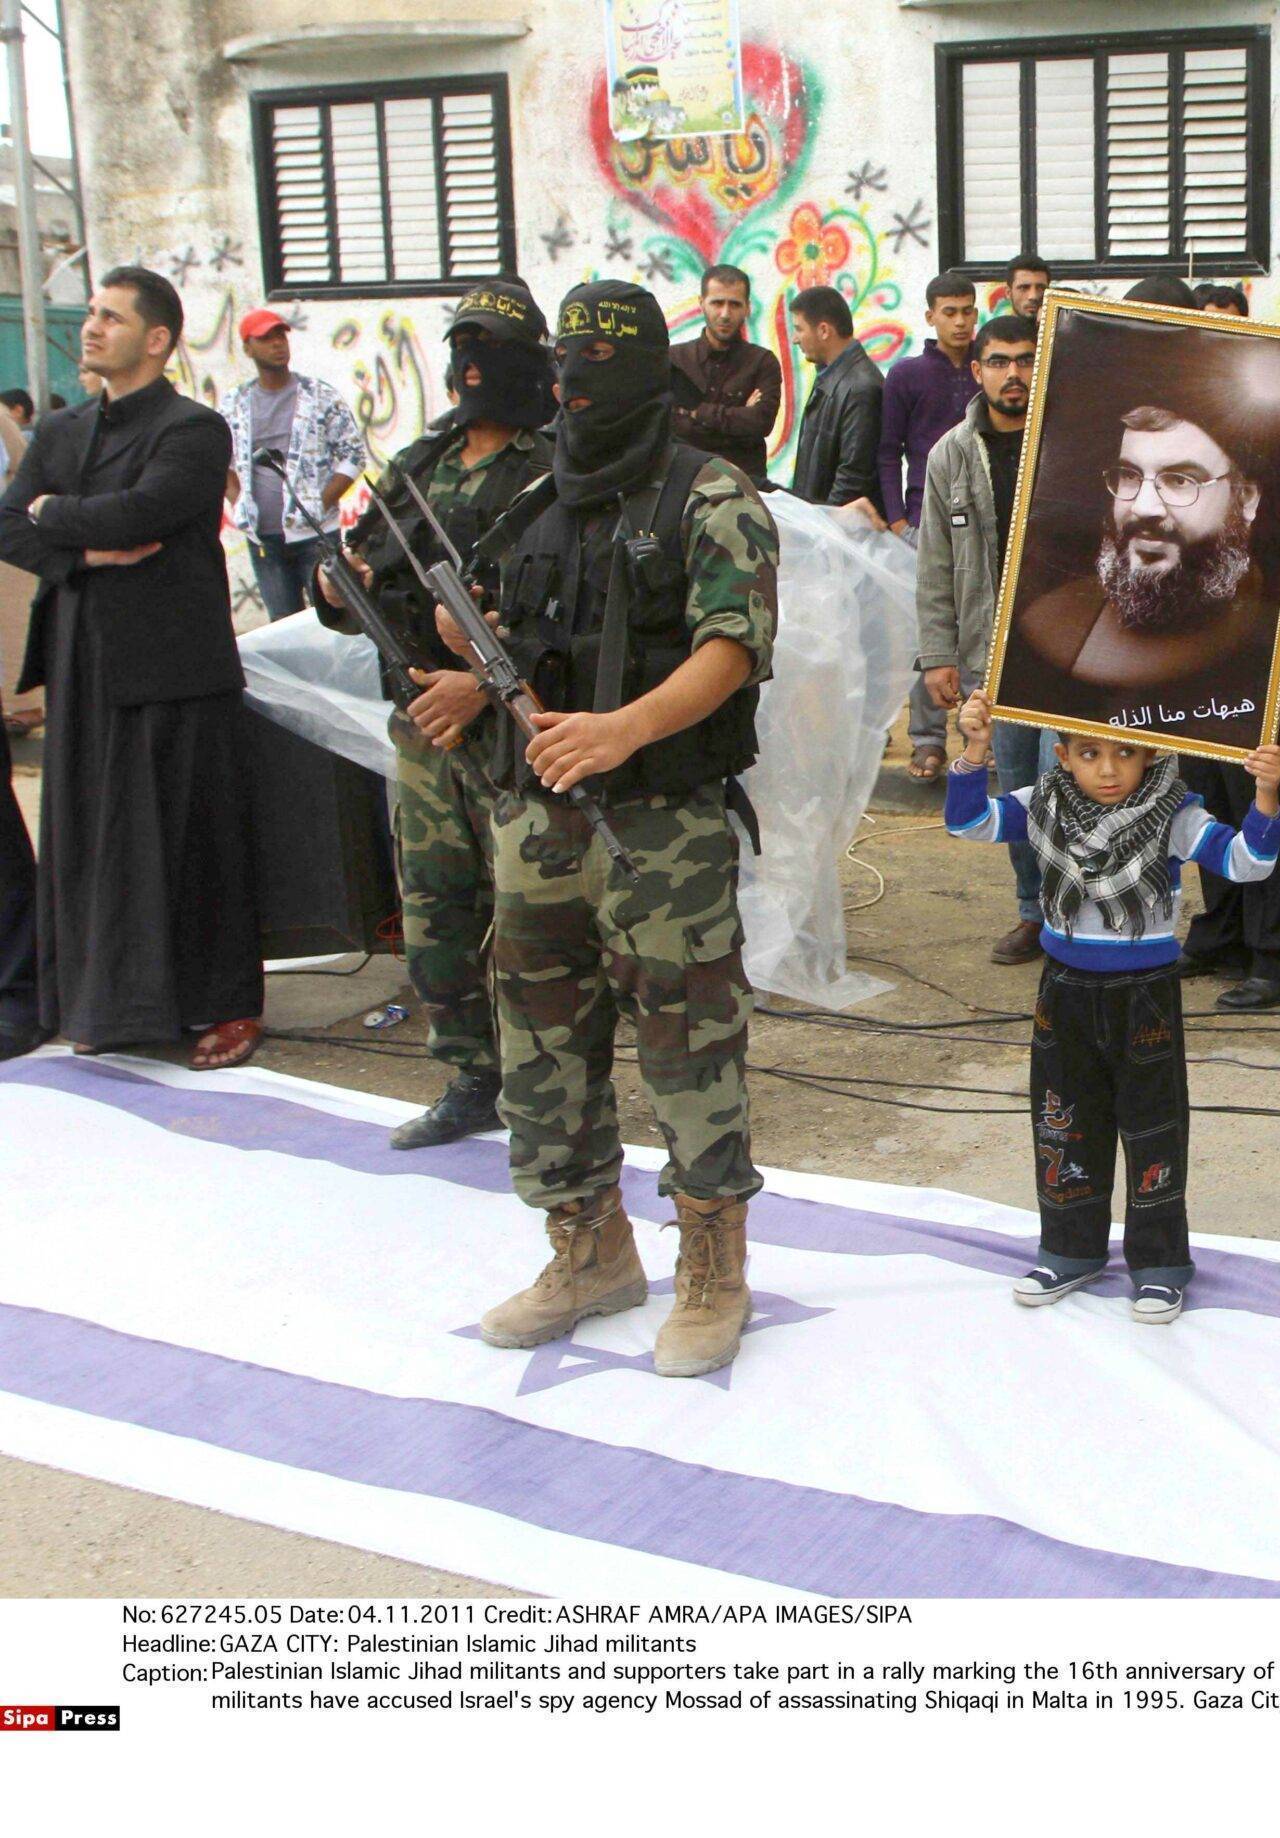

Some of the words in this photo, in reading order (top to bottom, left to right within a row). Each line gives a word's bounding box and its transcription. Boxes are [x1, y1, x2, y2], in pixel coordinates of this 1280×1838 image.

[597, 310, 638, 338] سرايا
[1158, 703, 1187, 724] منا
[1192, 696, 1256, 721] هيهات
